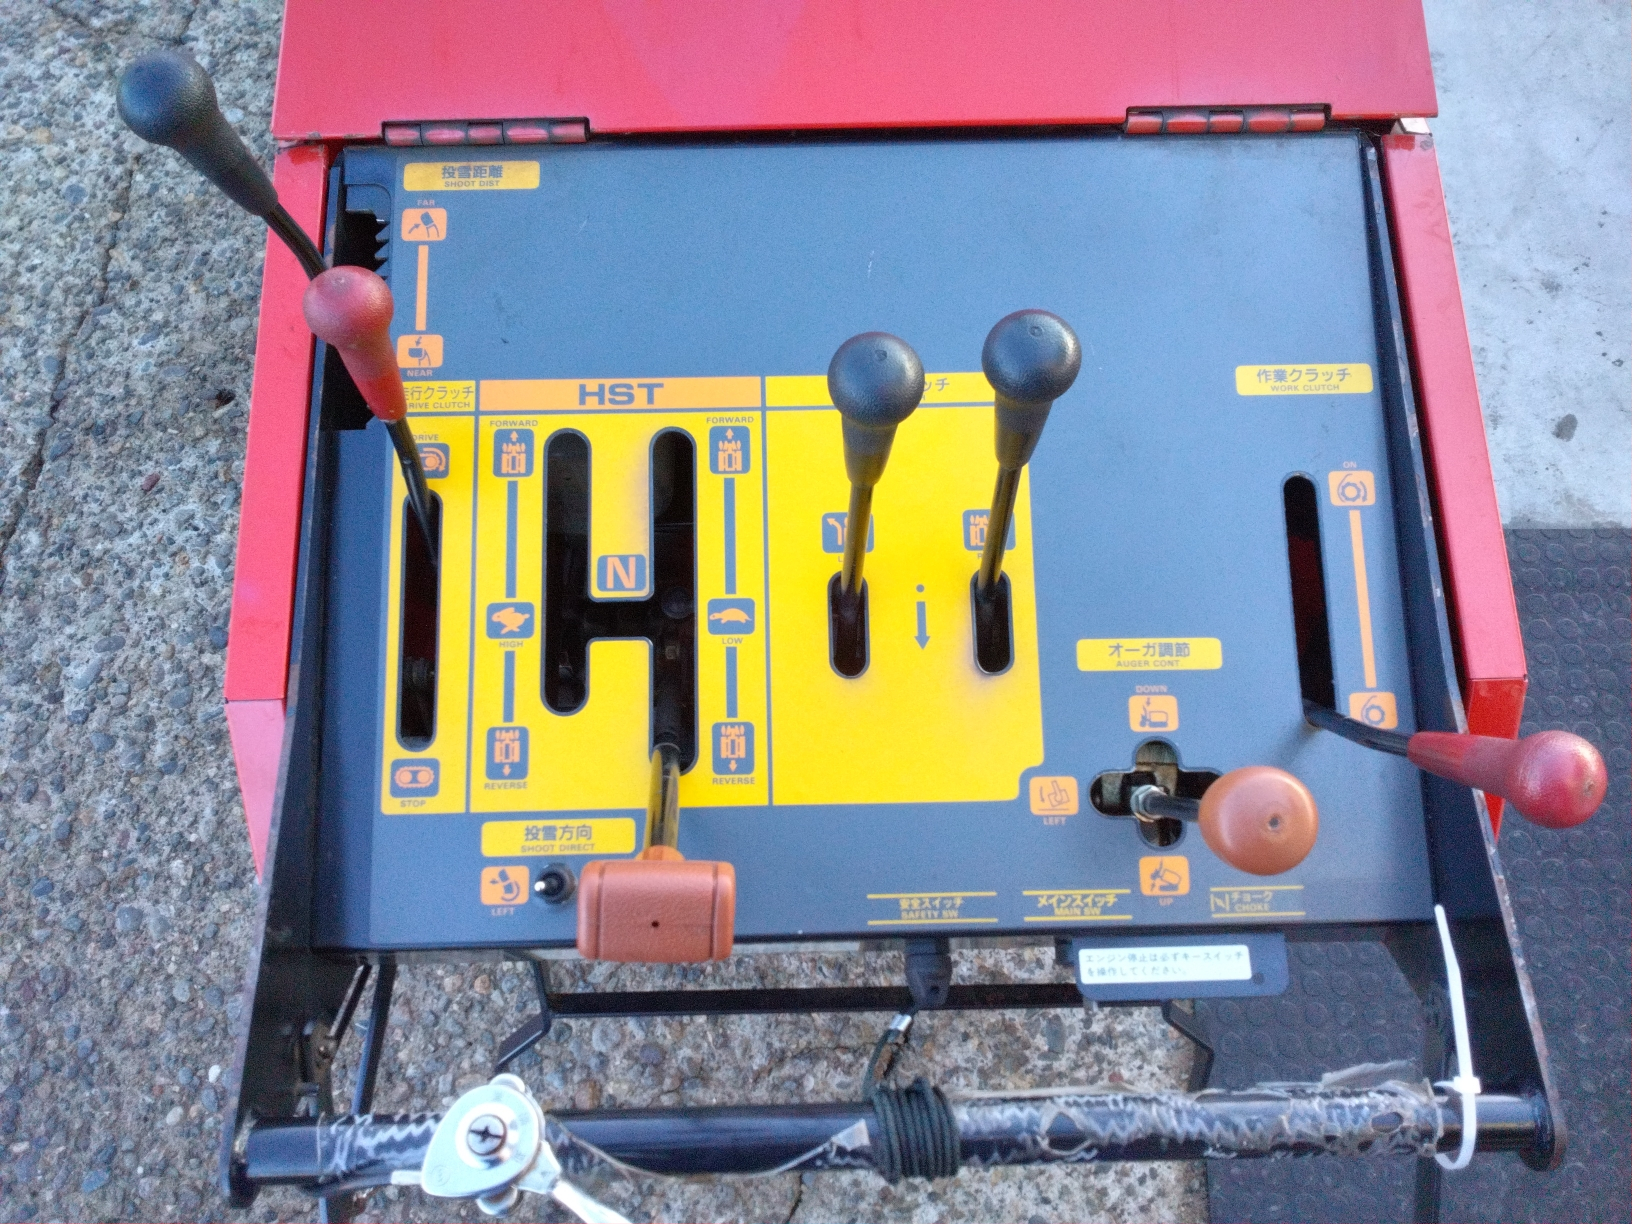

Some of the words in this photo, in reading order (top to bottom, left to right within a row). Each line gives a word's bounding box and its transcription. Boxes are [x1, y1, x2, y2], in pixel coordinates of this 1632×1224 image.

[441, 164, 504, 180] 投雪距離
[444, 180, 476, 188] SHOOT
[406, 369, 433, 377] NEAR
[1257, 368, 1351, 384] 作業クラッチ
[1303, 384, 1340, 392] CLUTCH
[578, 383, 664, 406] HST
[408, 402, 430, 410] RIVE
[432, 401, 471, 409] CLUTCH
[489, 419, 539, 428] FORWARD
[706, 416, 755, 424] FORWARD
[1343, 461, 1357, 469] ON
[606, 556, 636, 589] N
[498, 640, 525, 649] HIGH
[721, 637, 744, 646] LOW
[1108, 643, 1190, 658] オーガ調節
[1116, 660, 1150, 668] AUGER
[1135, 685, 1168, 693] DOWN
[484, 781, 528, 790] REVERSE
[712, 777, 756, 785] REVERSE
[400, 799, 427, 808] STOP
[1042, 816, 1068, 826] LEFT
[524, 825, 593, 842] 投雪方向
[521, 844, 555, 852] SHOOT
[559, 843, 595, 851] DIRECT
[1037, 894, 1117, 908] メインスイッチ
[1231, 892, 1273, 902] チョーク
[1158, 898, 1173, 906] UP
[491, 906, 515, 916] LEFT
[1054, 907, 1081, 917] MAIN
[1083, 906, 1101, 916] SW
[1235, 903, 1270, 912] CHOKE
[901, 910, 938, 919] SAFETY
